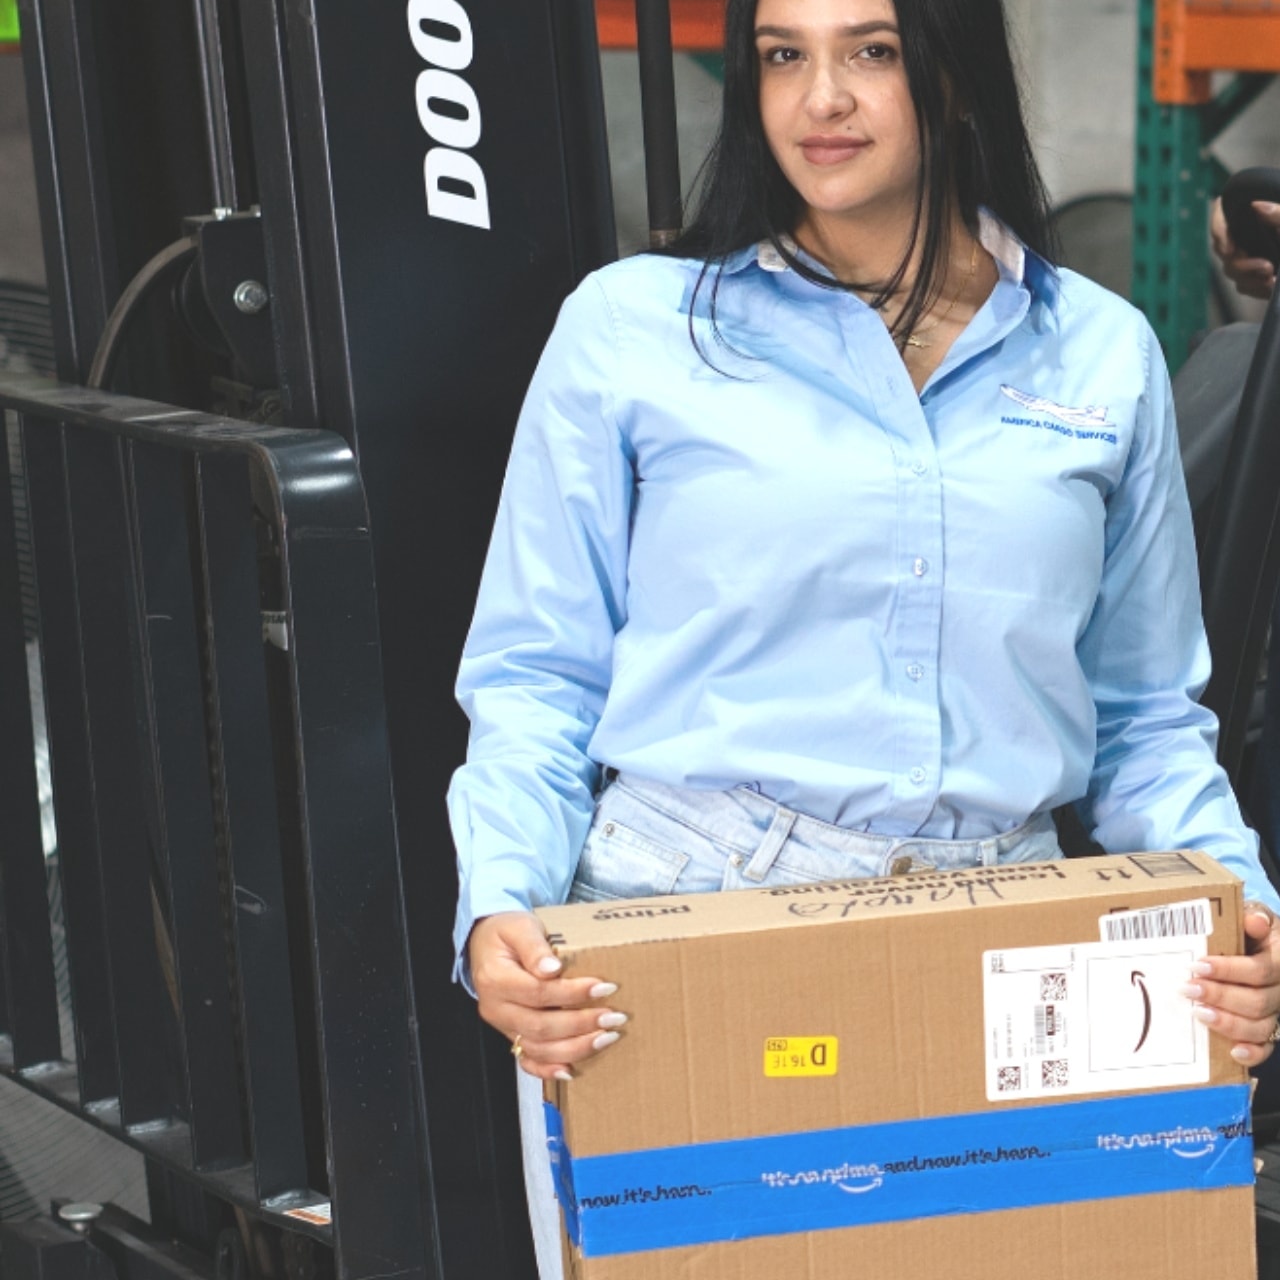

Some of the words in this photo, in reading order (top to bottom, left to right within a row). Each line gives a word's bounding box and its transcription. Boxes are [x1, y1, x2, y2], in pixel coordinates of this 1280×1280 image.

[905, 871, 969, 883] you
[975, 864, 1059, 876] keep
[848, 881, 947, 897] never
[592, 904, 692, 921] prime
[811, 1042, 827, 1067] D
[1156, 1125, 1218, 1150] prime
[821, 1162, 886, 1186] prime
[921, 1154, 961, 1170] now
[962, 1148, 993, 1166] it's
[580, 1193, 620, 1209] now
[623, 1186, 654, 1204] it's
